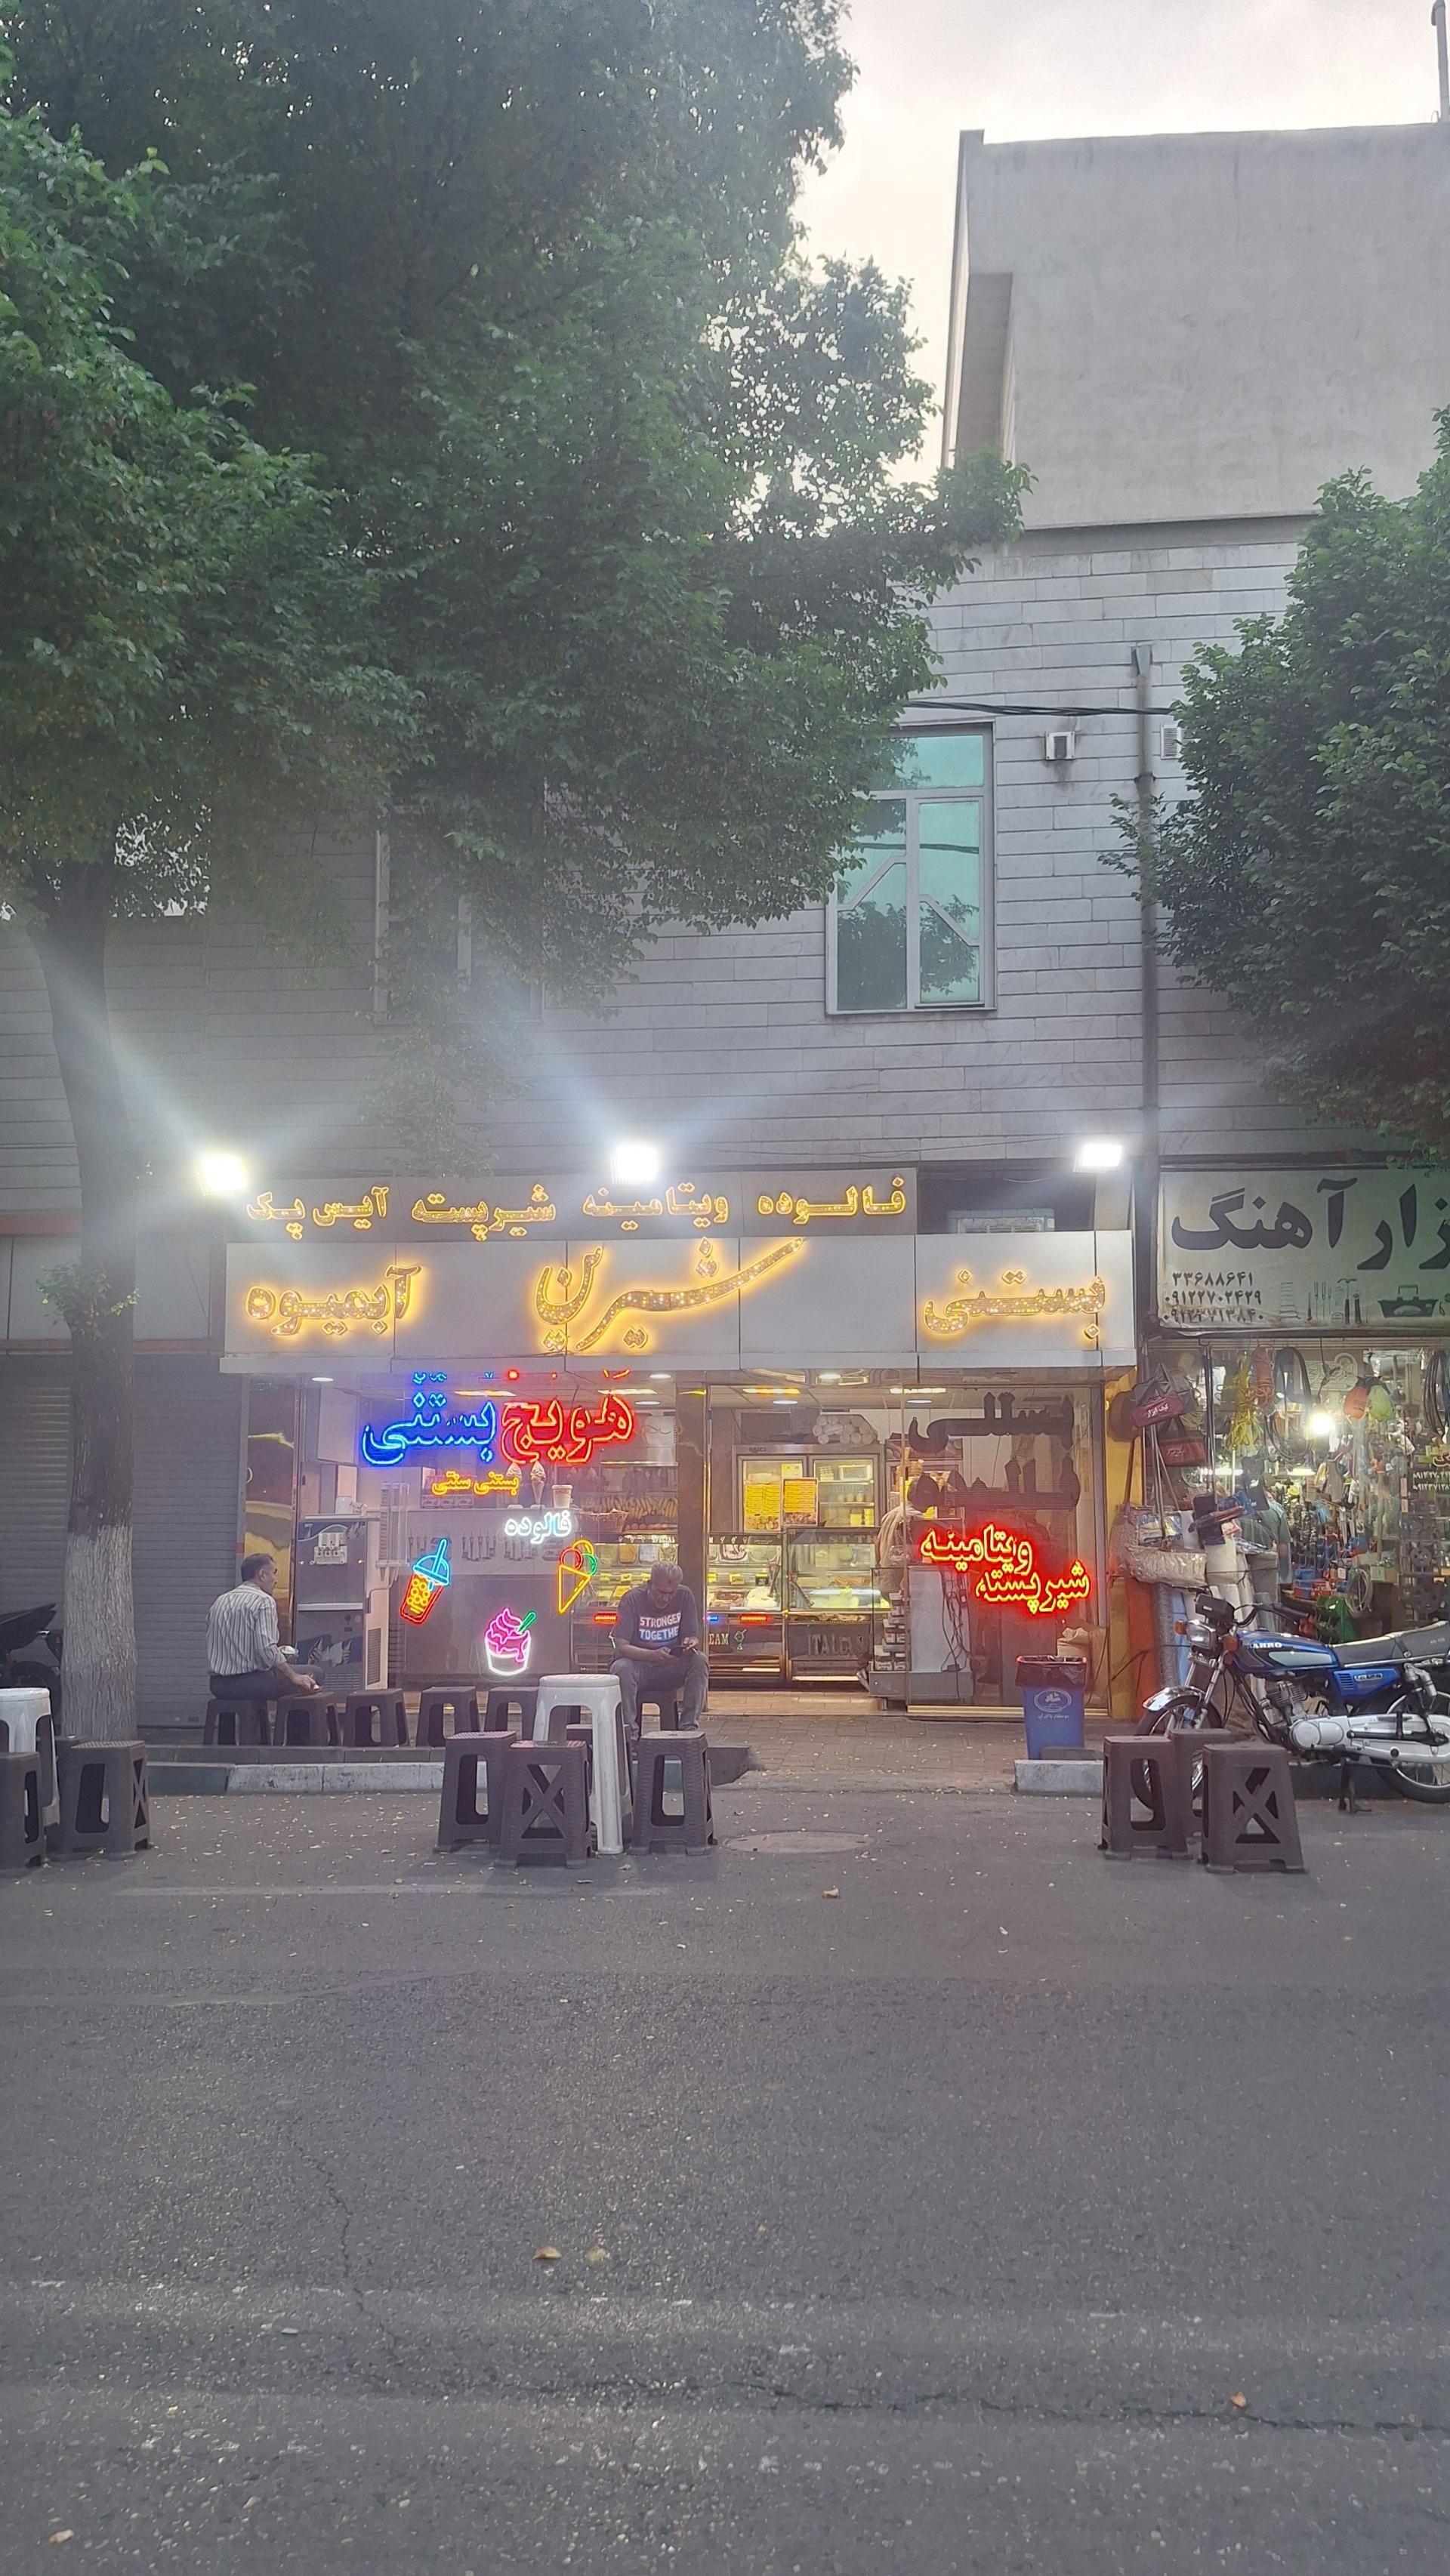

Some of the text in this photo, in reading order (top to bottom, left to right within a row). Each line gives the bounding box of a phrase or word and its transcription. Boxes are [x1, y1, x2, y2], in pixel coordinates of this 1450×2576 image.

[247, 1192, 305, 1240] پک
[313, 1186, 389, 1229] آیس
[582, 1183, 729, 1230] ویتامینه
[757, 1176, 906, 1225] فالوده
[1171, 1177, 1450, 1270] زار آهنگ
[245, 1265, 421, 1336] آبمیوه
[1165, 1290, 1262, 1305] ۰۹۱۲۲۷۰۲۴۲۹
[1172, 1271, 1253, 1286] ۳۳۶۸۸۶۴۱
[923, 1268, 1106, 1339] بستنی
[361, 1392, 496, 1465] بستنی
[431, 1471, 520, 1496] بستنی سنتی
[504, 1510, 572, 1544] فالوده
[920, 1524, 1033, 1575] ویتامینه
[639, 1627, 680, 1641] TOGETHE
[640, 1612, 681, 1628] STRONGER
[708, 1633, 729, 1645] EAM
